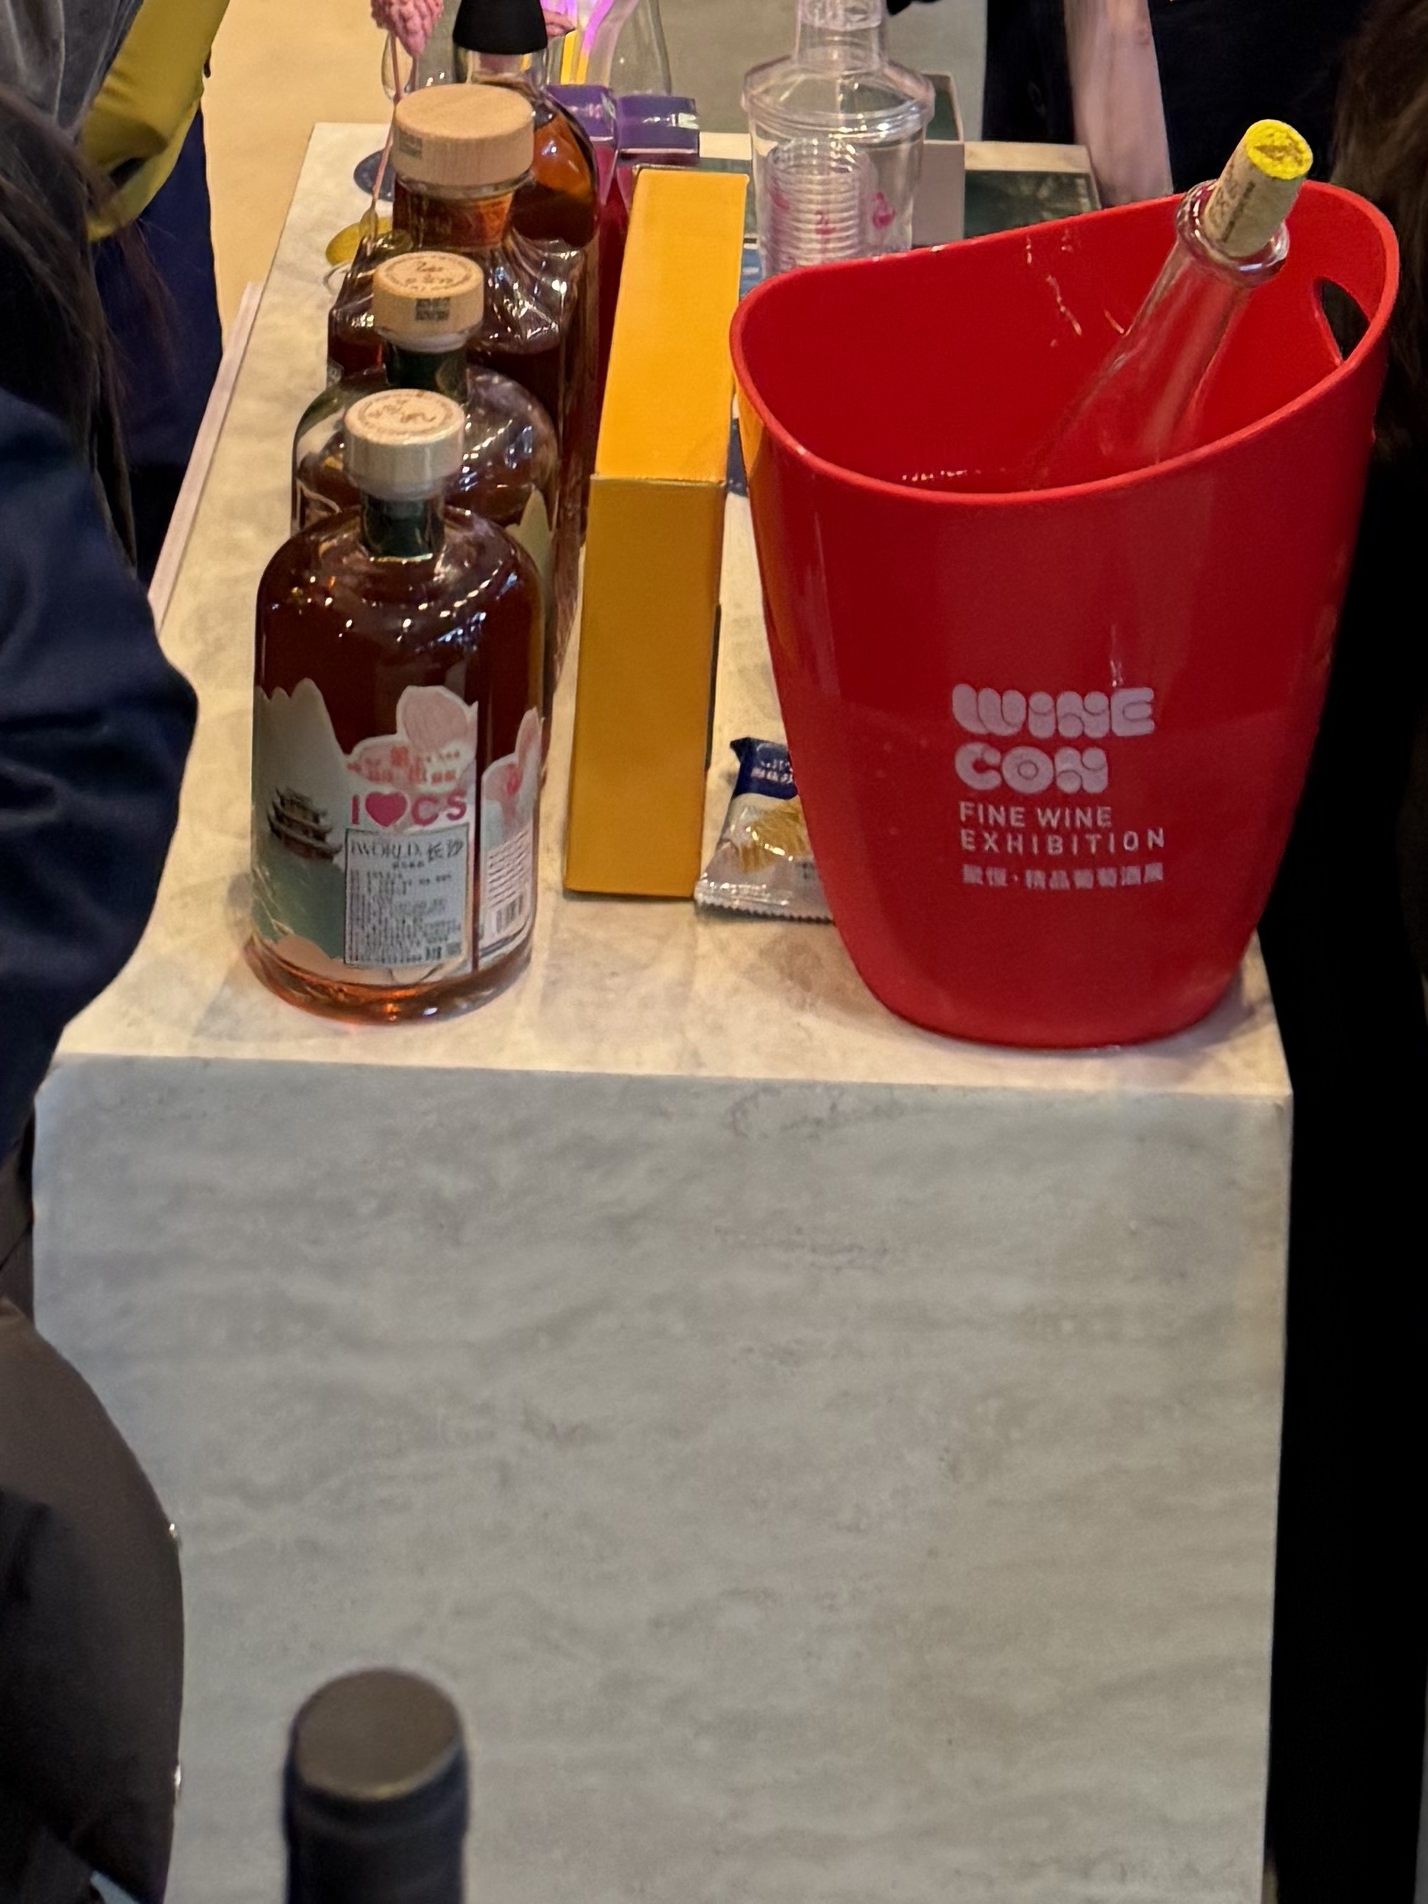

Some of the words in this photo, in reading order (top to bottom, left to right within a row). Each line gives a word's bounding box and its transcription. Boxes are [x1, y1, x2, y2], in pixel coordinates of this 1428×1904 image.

[954, 742, 1109, 795] CON
[410, 789, 468, 827] CS
[959, 801, 1025, 828] FINE
[1037, 806, 1112, 829] WINE
[960, 827, 1165, 856] EXHIBITION
